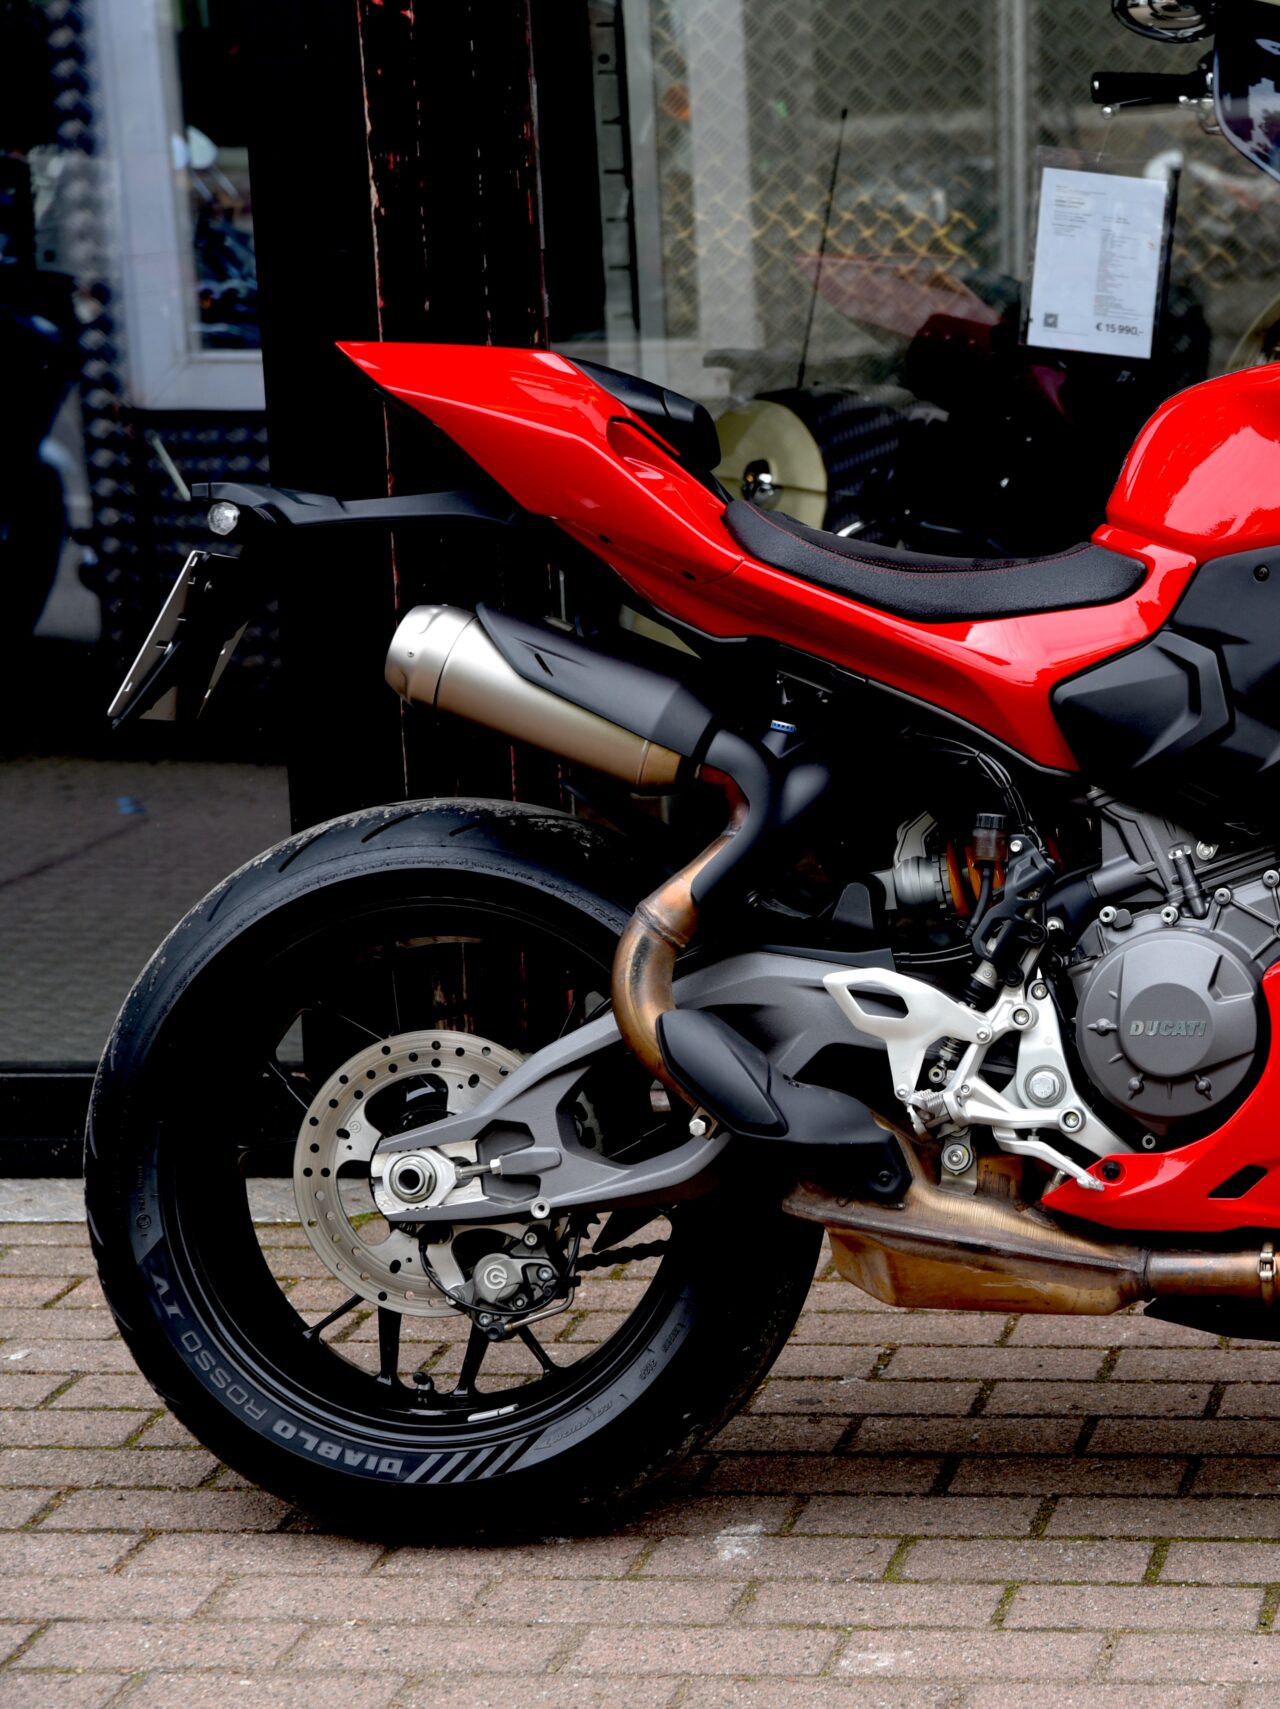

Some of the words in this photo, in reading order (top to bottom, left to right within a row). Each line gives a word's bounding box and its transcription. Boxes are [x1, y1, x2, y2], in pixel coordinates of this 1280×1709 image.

[1129, 1020, 1207, 1037] DUCATI
[150, 1274, 186, 1320] IV
[180, 1330, 268, 1421] ROSSO
[272, 1419, 404, 1478] DIABLO
